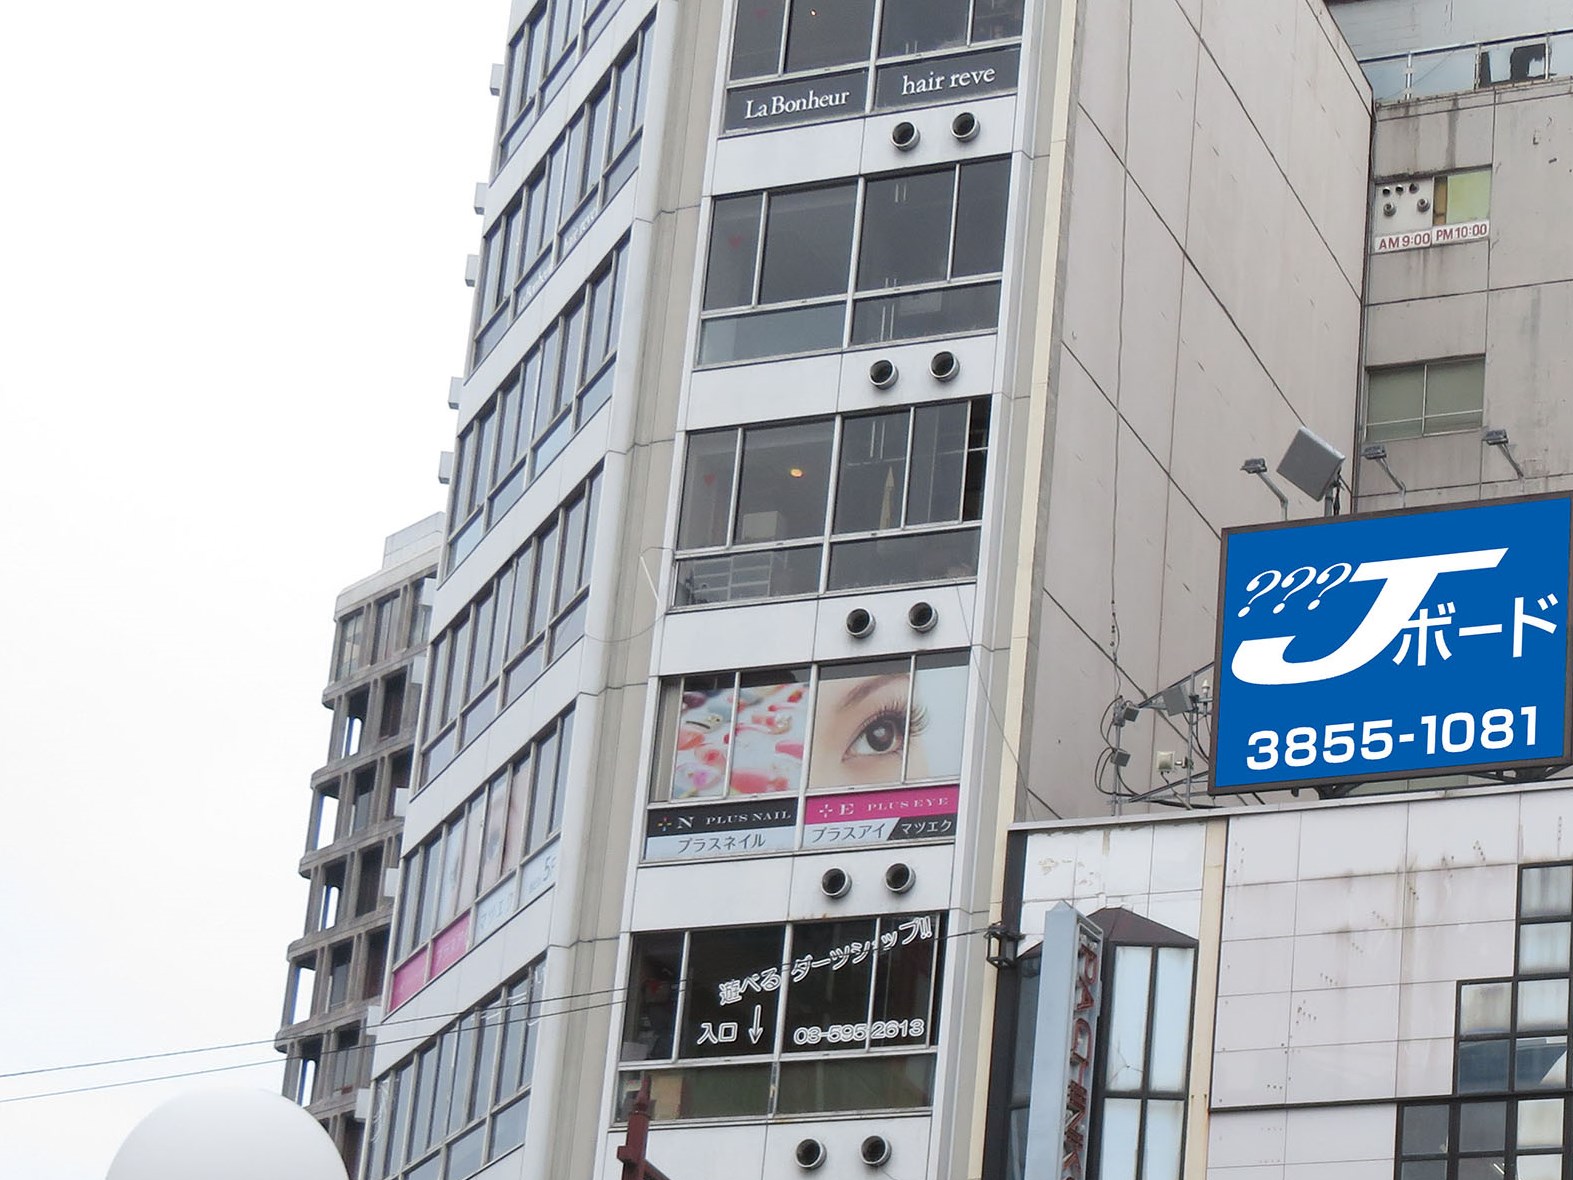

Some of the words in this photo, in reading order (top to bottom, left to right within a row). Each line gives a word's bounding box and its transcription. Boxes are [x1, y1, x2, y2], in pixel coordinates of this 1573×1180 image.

[901, 70, 944, 96] hair
[950, 67, 996, 88] reve
[744, 99, 768, 119] La
[771, 89, 850, 116] Bonheur
[1379, 237, 1400, 250] AM
[1402, 232, 1431, 247] 9:00
[1436, 228, 1453, 241] PM
[1454, 223, 1488, 239] 10:00
[1246, 705, 1538, 772] 3855-1081
[866, 800, 909, 812] PLUS
[913, 797, 949, 809] EYE
[706, 813, 748, 825] PLUS
[752, 810, 792, 823] NAIL
[901, 818, 953, 836] マツエク
[812, 822, 886, 844] プラスアイ
[719, 967, 782, 1006] 遊べる
[697, 1021, 739, 1045] 入口
